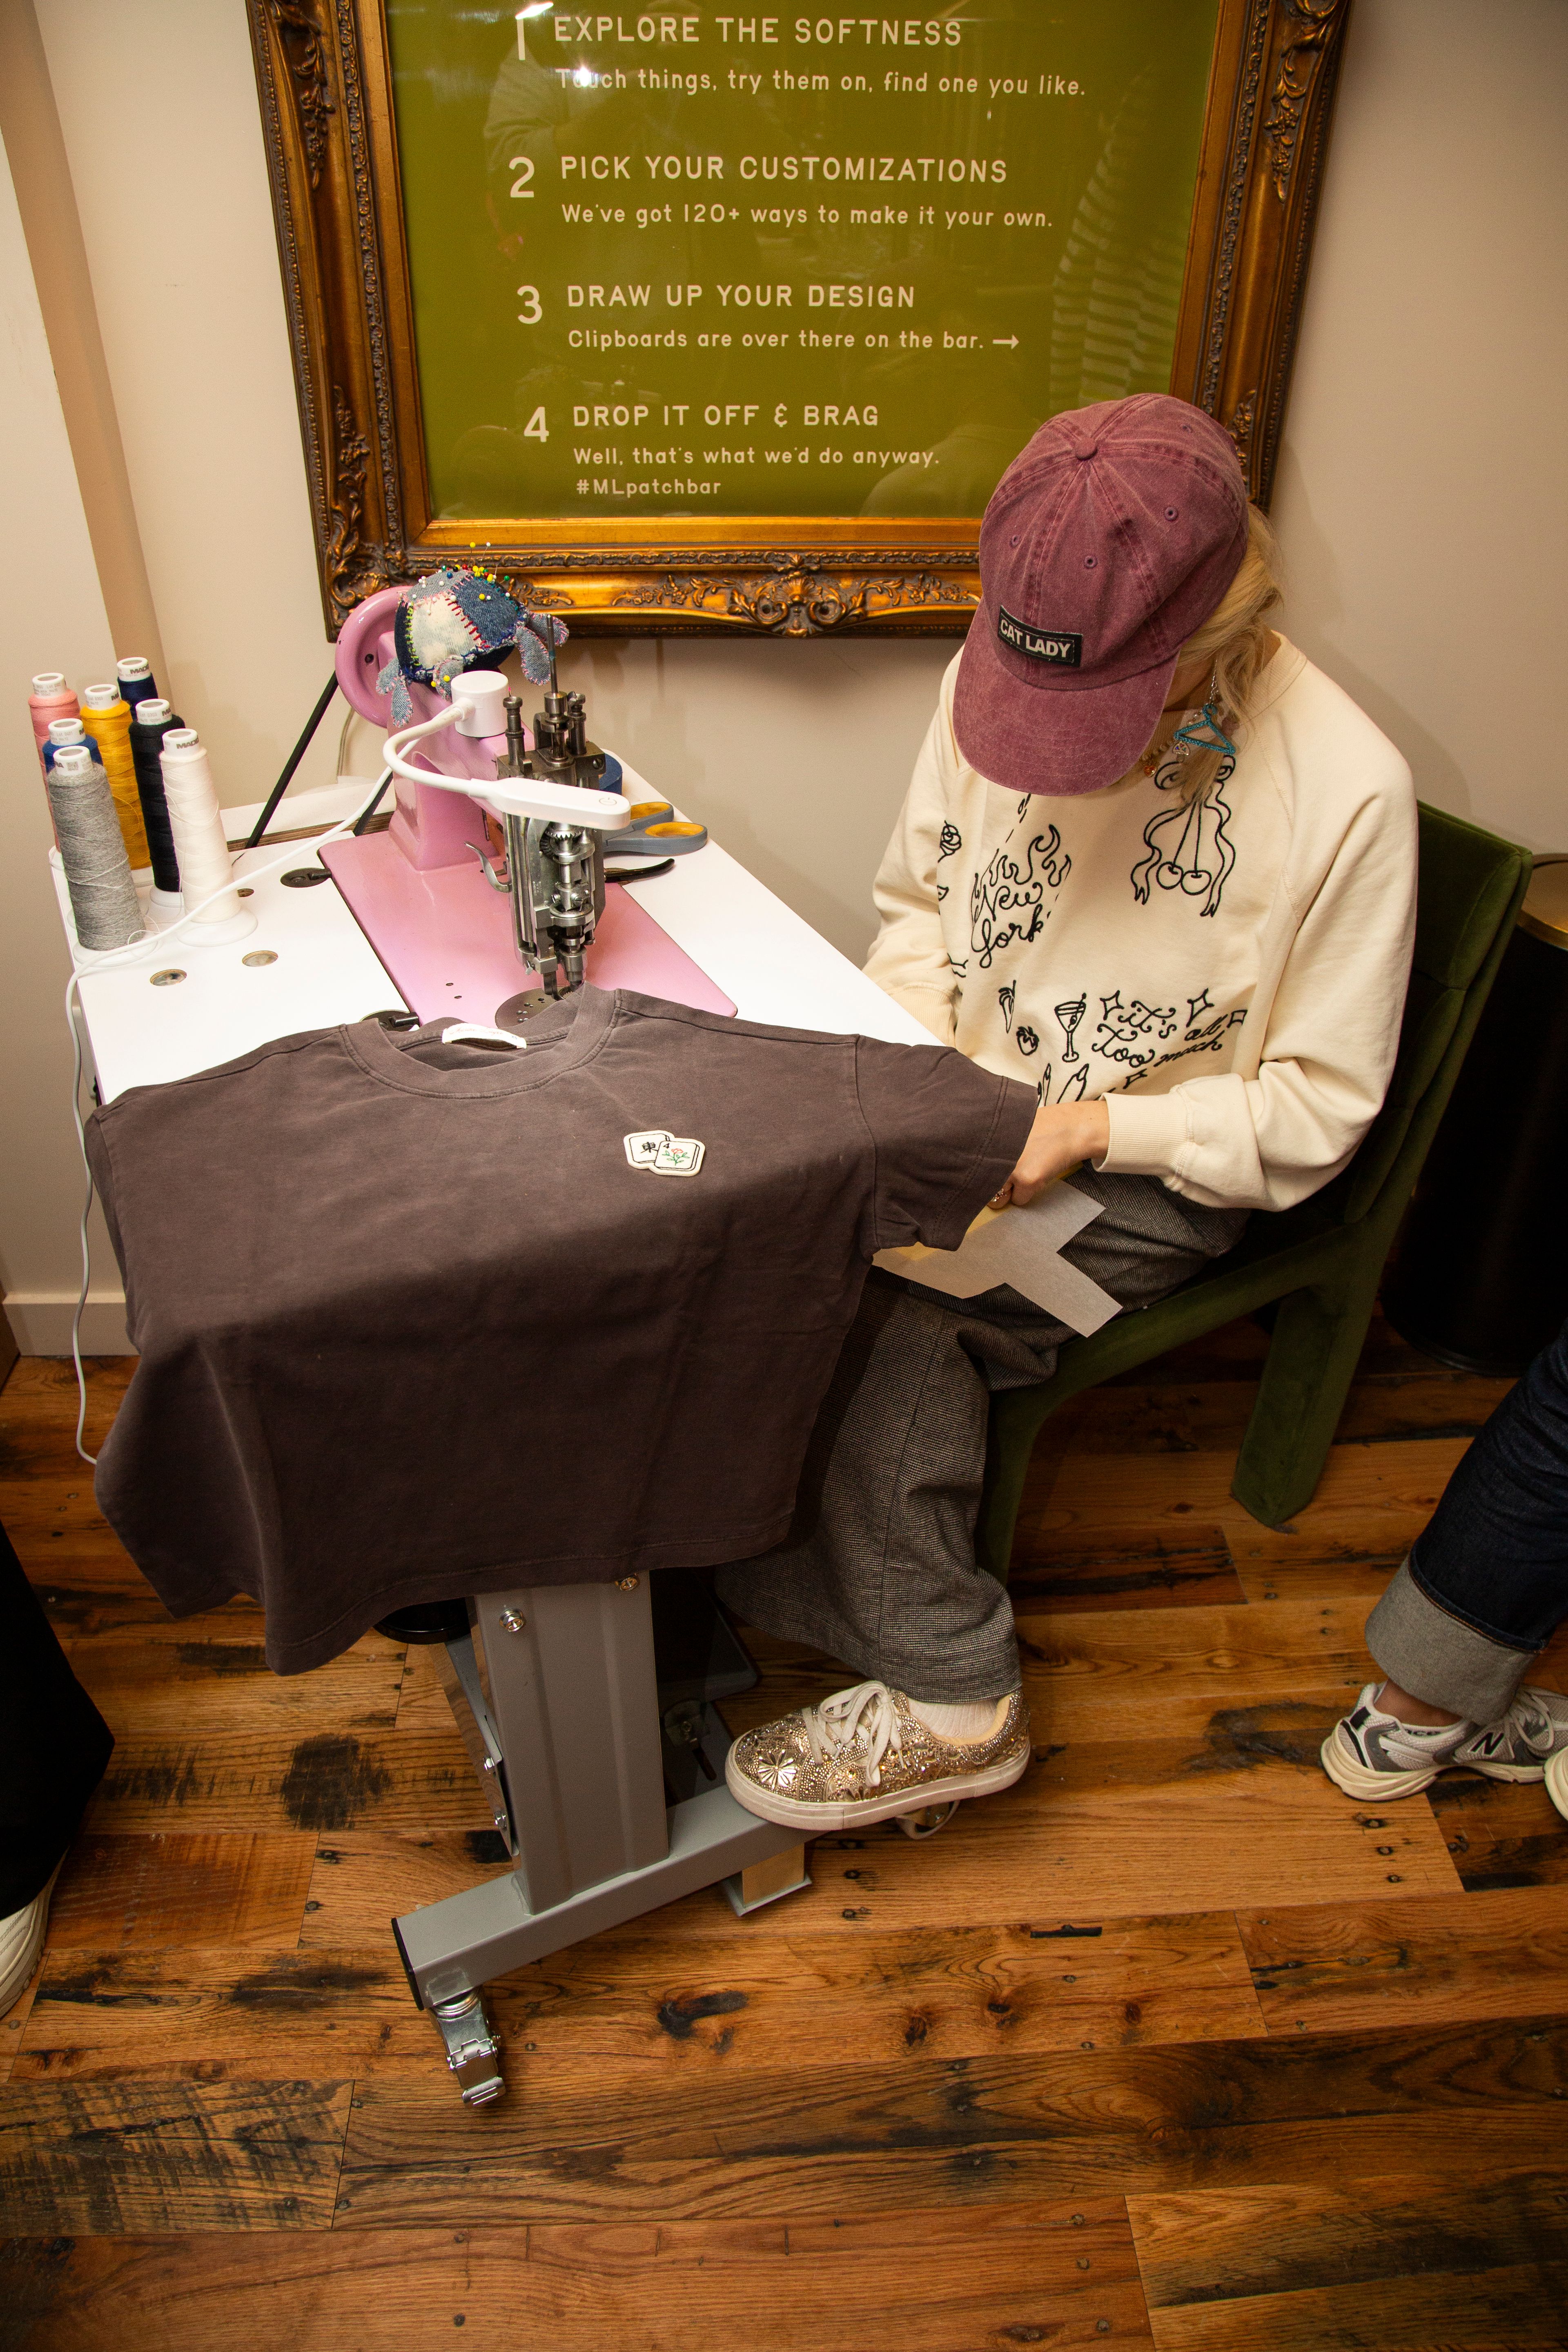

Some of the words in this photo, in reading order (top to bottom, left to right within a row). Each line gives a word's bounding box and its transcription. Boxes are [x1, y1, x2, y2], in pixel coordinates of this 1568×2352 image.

[555, 16, 699, 42] EXPLORE
[716, 18, 778, 42] THE
[795, 19, 962, 45] SOFTNESS
[638, 69, 716, 95] things,
[728, 70, 761, 94] try
[773, 70, 829, 89] them
[841, 76, 872, 92] on,
[884, 72, 927, 91] find
[939, 78, 977, 92] one
[989, 79, 1027, 97] you
[1040, 76, 1084, 94] like.
[509, 156, 534, 198] 2
[561, 156, 630, 179] PICK
[645, 156, 723, 179] YOUR
[740, 156, 1006, 183] CUSTOMIZATIONS
[562, 205, 625, 222] We've
[636, 204, 671, 228] got
[685, 204, 739, 222] 120+
[751, 209, 806, 227] ways
[818, 205, 839, 223] to
[851, 206, 908, 223] make
[920, 207, 934, 224] it
[946, 212, 993, 229] your
[1004, 213, 1051, 226] own.
[517, 285, 542, 324] 3
[568, 285, 650, 307] DRAW
[667, 285, 702, 306] UP
[717, 285, 791, 306] YOUR
[809, 285, 913, 307] DESIGN
[569, 330, 686, 351] Clipboards
[698, 334, 731, 346] are
[742, 334, 788, 346] over
[799, 330, 854, 347] there
[865, 335, 888, 347] on
[900, 331, 932, 347] the
[944, 332, 982, 348] bar.
[524, 407, 549, 442] 4
[574, 405, 648, 426] DROP
[664, 405, 689, 425] IT
[705, 405, 759, 425] OFF
[774, 403, 787, 427] &
[804, 405, 877, 425] BRAG
[574, 448, 623, 465] Well,
[633, 448, 693, 463] that's
[704, 447, 754, 463] what
[765, 448, 808, 463] we'd
[820, 448, 842, 463] do
[853, 452, 938, 468] anyway.
[577, 478, 721, 498] #MLpatchbar
[1000, 619, 1022, 645] CAT
[1026, 635, 1071, 657] LADY
[975, 882, 1043, 922] New
[971, 903, 1044, 969] York
[1184, 1013, 1228, 1041] all
[1091, 1024, 1156, 1068] too
[1153, 1029, 1223, 1067] much
[640, 1142, 659, 1154] 東
[1470, 1732, 1505, 1755] N
